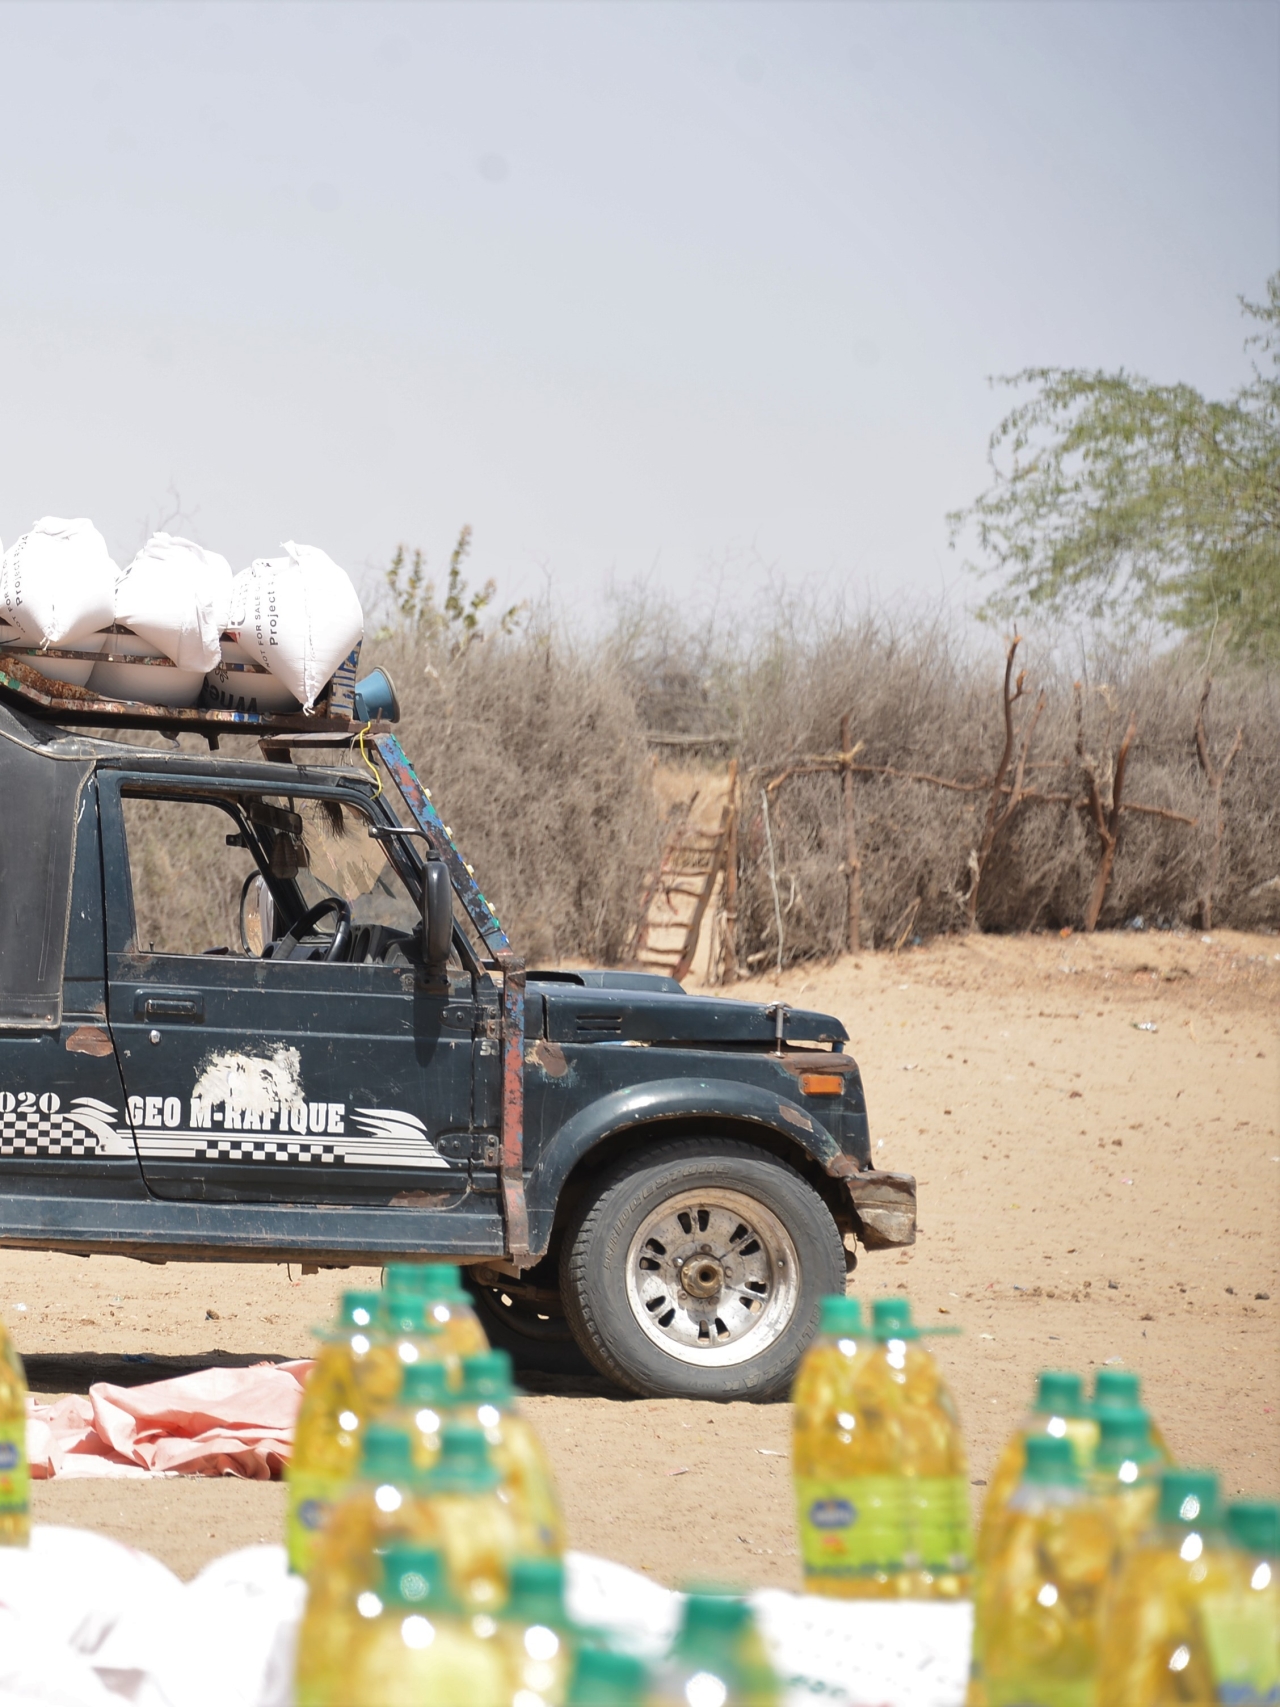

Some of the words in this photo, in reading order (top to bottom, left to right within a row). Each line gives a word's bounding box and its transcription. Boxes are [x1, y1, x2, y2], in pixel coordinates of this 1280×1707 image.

[254, 595, 262, 621] SALE
[267, 589, 279, 647] Project
[255, 624, 265, 647] FOR
[125, 1095, 182, 1127] GEO
[189, 1097, 346, 1135] M-RAFIQUE
